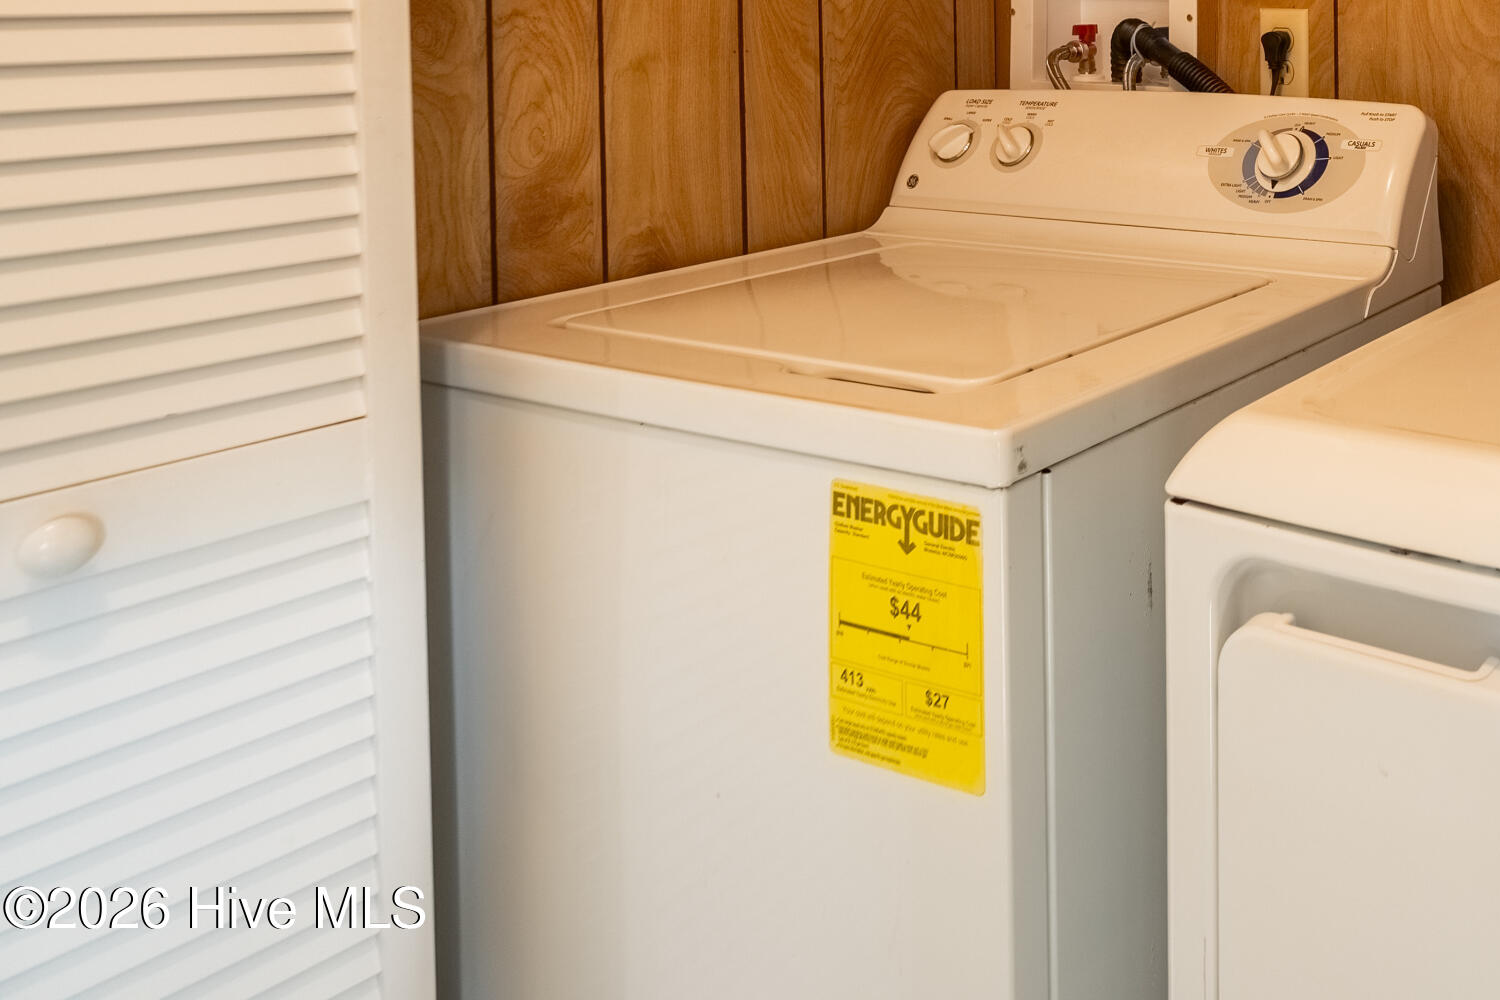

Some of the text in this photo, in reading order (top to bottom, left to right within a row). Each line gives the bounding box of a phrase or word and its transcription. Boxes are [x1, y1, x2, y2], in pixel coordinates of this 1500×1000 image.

[1205, 146, 1227, 154] WHITES
[1347, 140, 1376, 148] CASUALS
[832, 490, 980, 547] ENERGYGUIDE
[862, 571, 887, 585] Estimated
[889, 578, 906, 590] Yearly
[906, 582, 933, 597] Operating
[934, 588, 948, 598] Cost
[889, 595, 922, 623] $44
[840, 668, 864, 688] 413
[925, 689, 949, 709] $27
